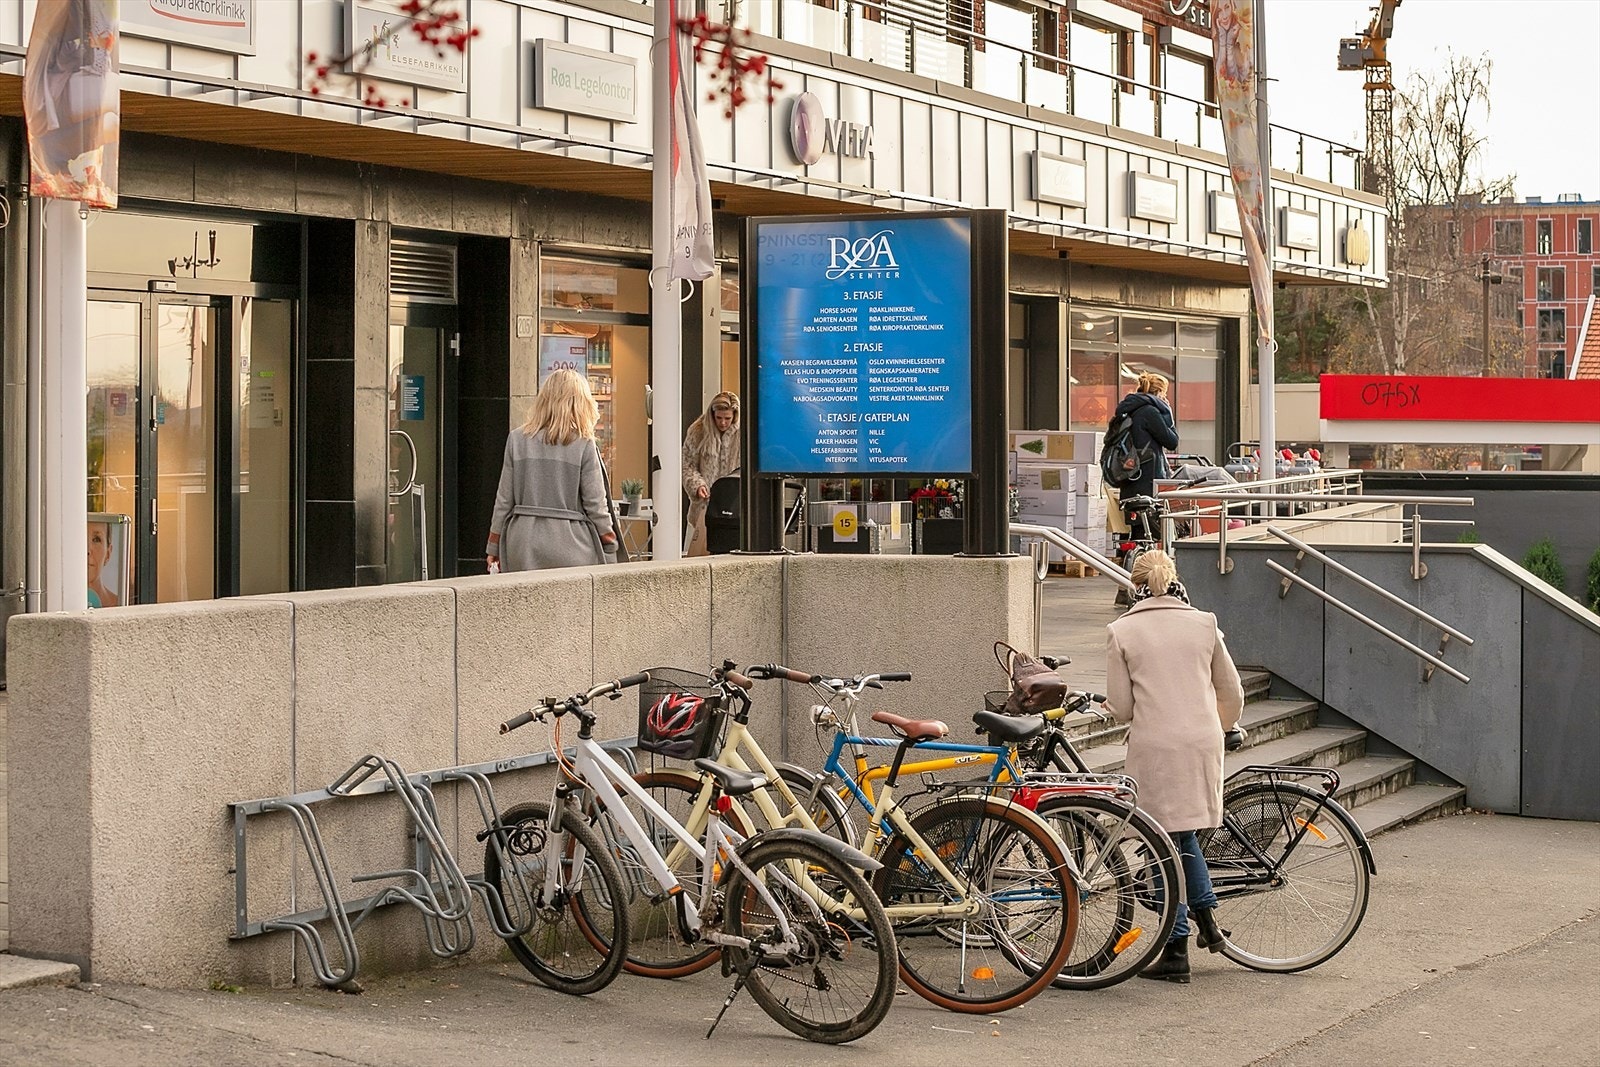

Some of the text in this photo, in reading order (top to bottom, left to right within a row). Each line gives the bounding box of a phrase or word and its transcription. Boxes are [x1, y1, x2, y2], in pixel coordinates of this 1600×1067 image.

[551, 68, 632, 101] Røa Legekontor
[825, 118, 875, 160] VITA
[826, 231, 899, 273] RØA
[843, 291, 883, 300] 3. ETASJE
[816, 325, 857, 333] SENIORSENTER
[843, 343, 883, 352] 2. ETASJE
[805, 358, 857, 366] BEGRAVELSESBYRÅ
[818, 413, 826, 422] 1.
[827, 413, 857, 422] ETASJE
[864, 413, 910, 422] GATEPLAN
